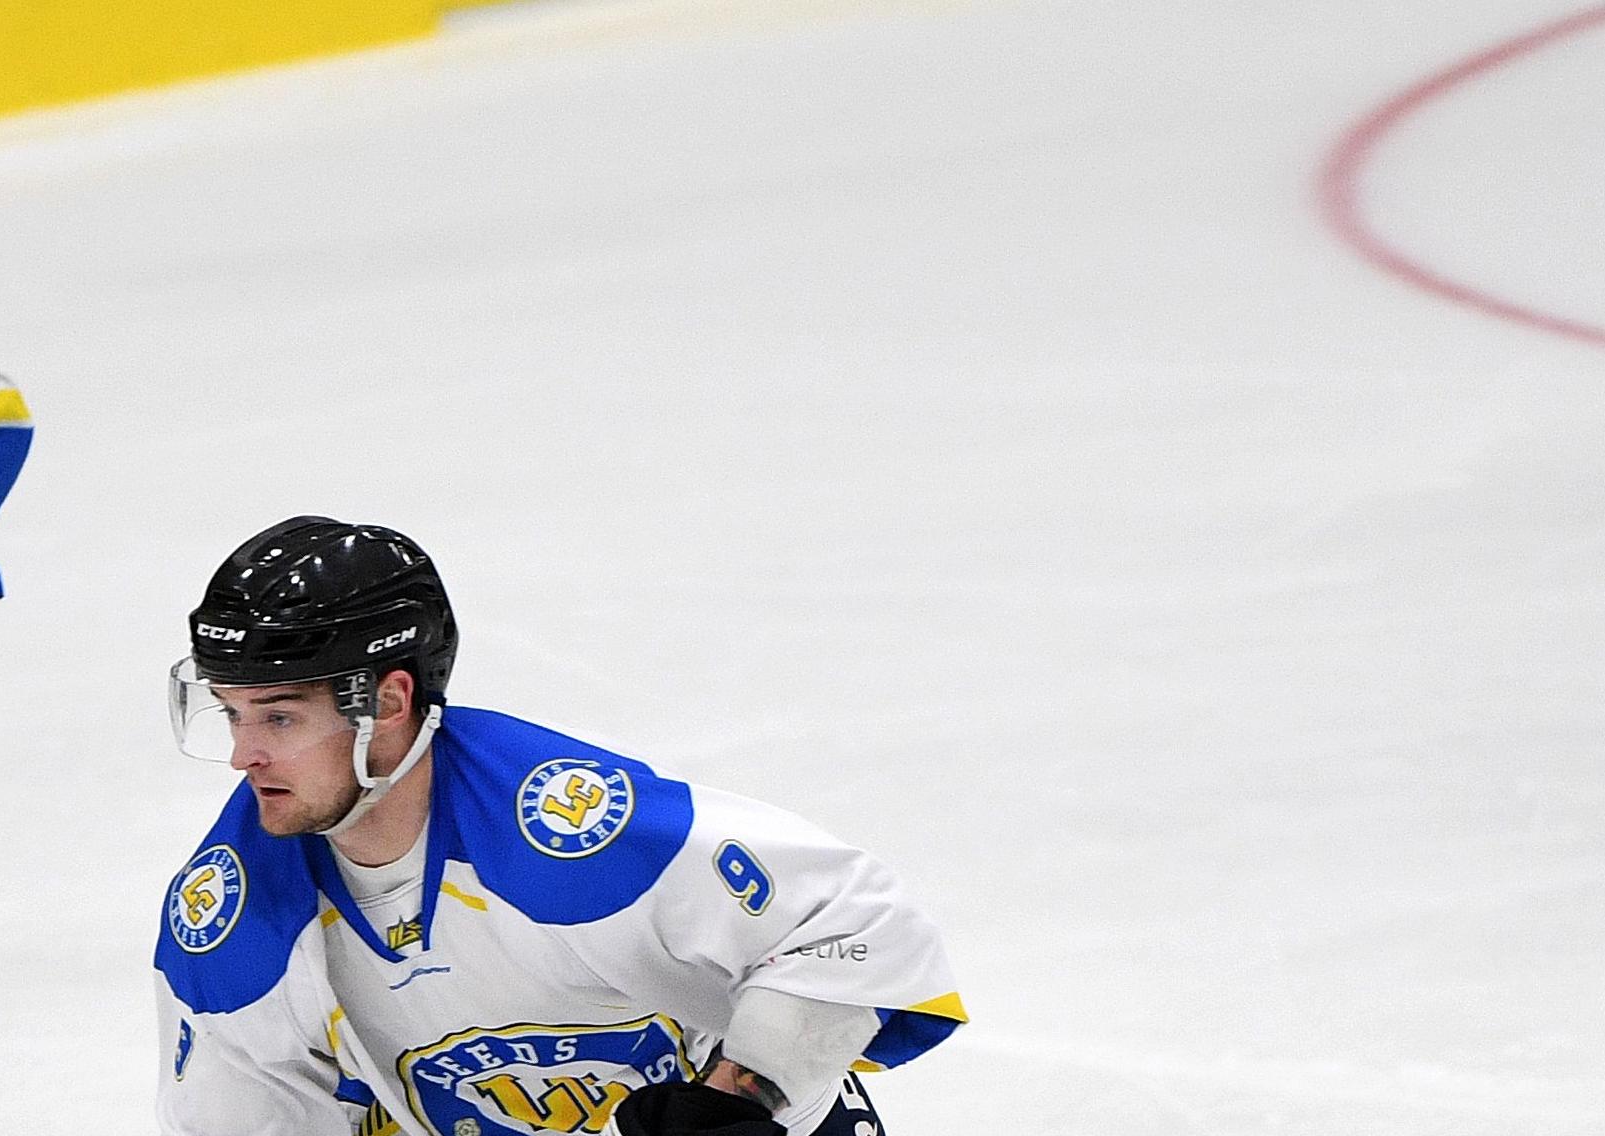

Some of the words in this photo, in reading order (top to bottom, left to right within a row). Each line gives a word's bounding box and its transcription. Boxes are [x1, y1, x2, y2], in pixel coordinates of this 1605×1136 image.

[196, 622, 247, 642] CCM
[366, 625, 417, 654] CCM
[712, 839, 776, 916] 9
[416, 1037, 578, 1090] LEEDS
